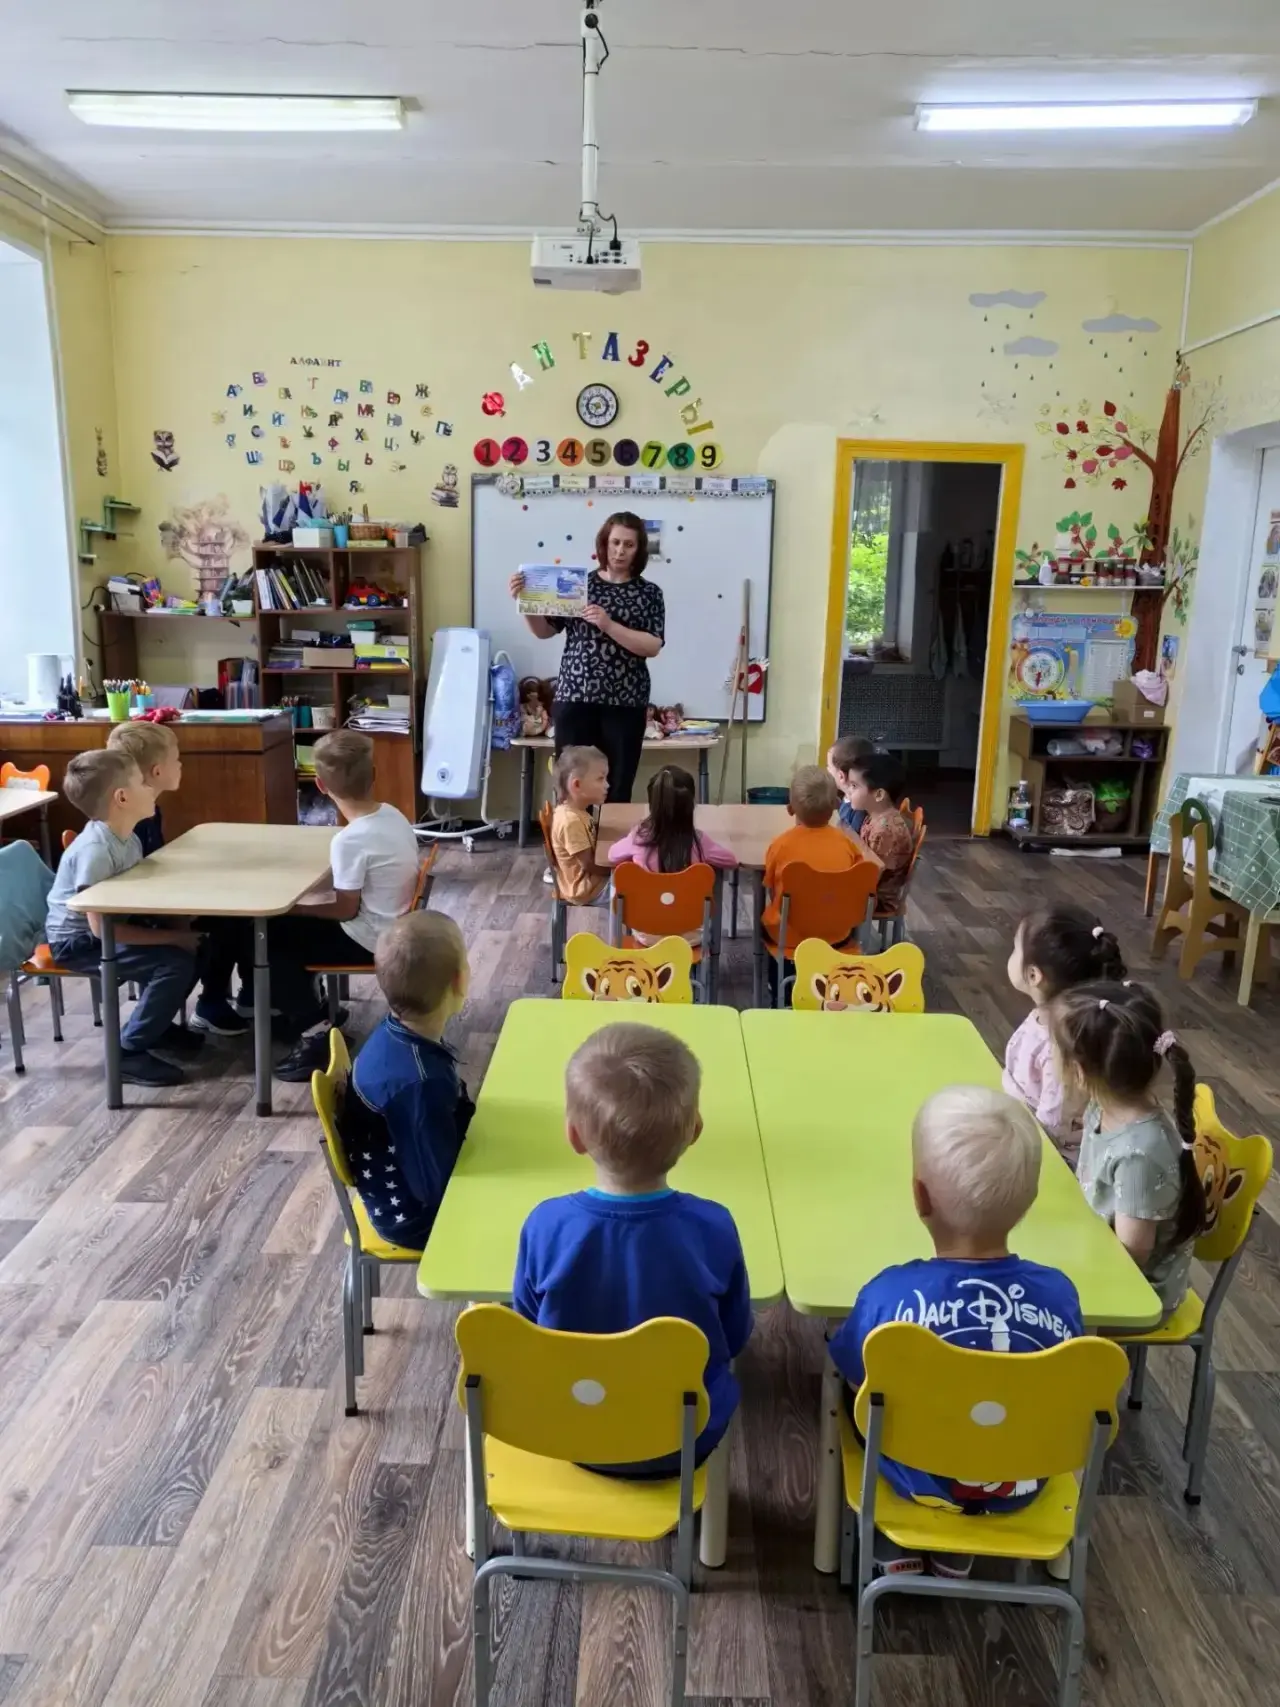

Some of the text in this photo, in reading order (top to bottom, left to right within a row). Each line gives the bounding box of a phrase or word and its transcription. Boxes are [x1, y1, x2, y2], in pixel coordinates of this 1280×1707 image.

[290, 356, 342, 367] АЛФАИТ
[415, 383, 429, 398] Ж
[481, 440, 717, 467] 1 2 3 4 5 6 7 8 9
[337, 458, 350, 472] Ы
